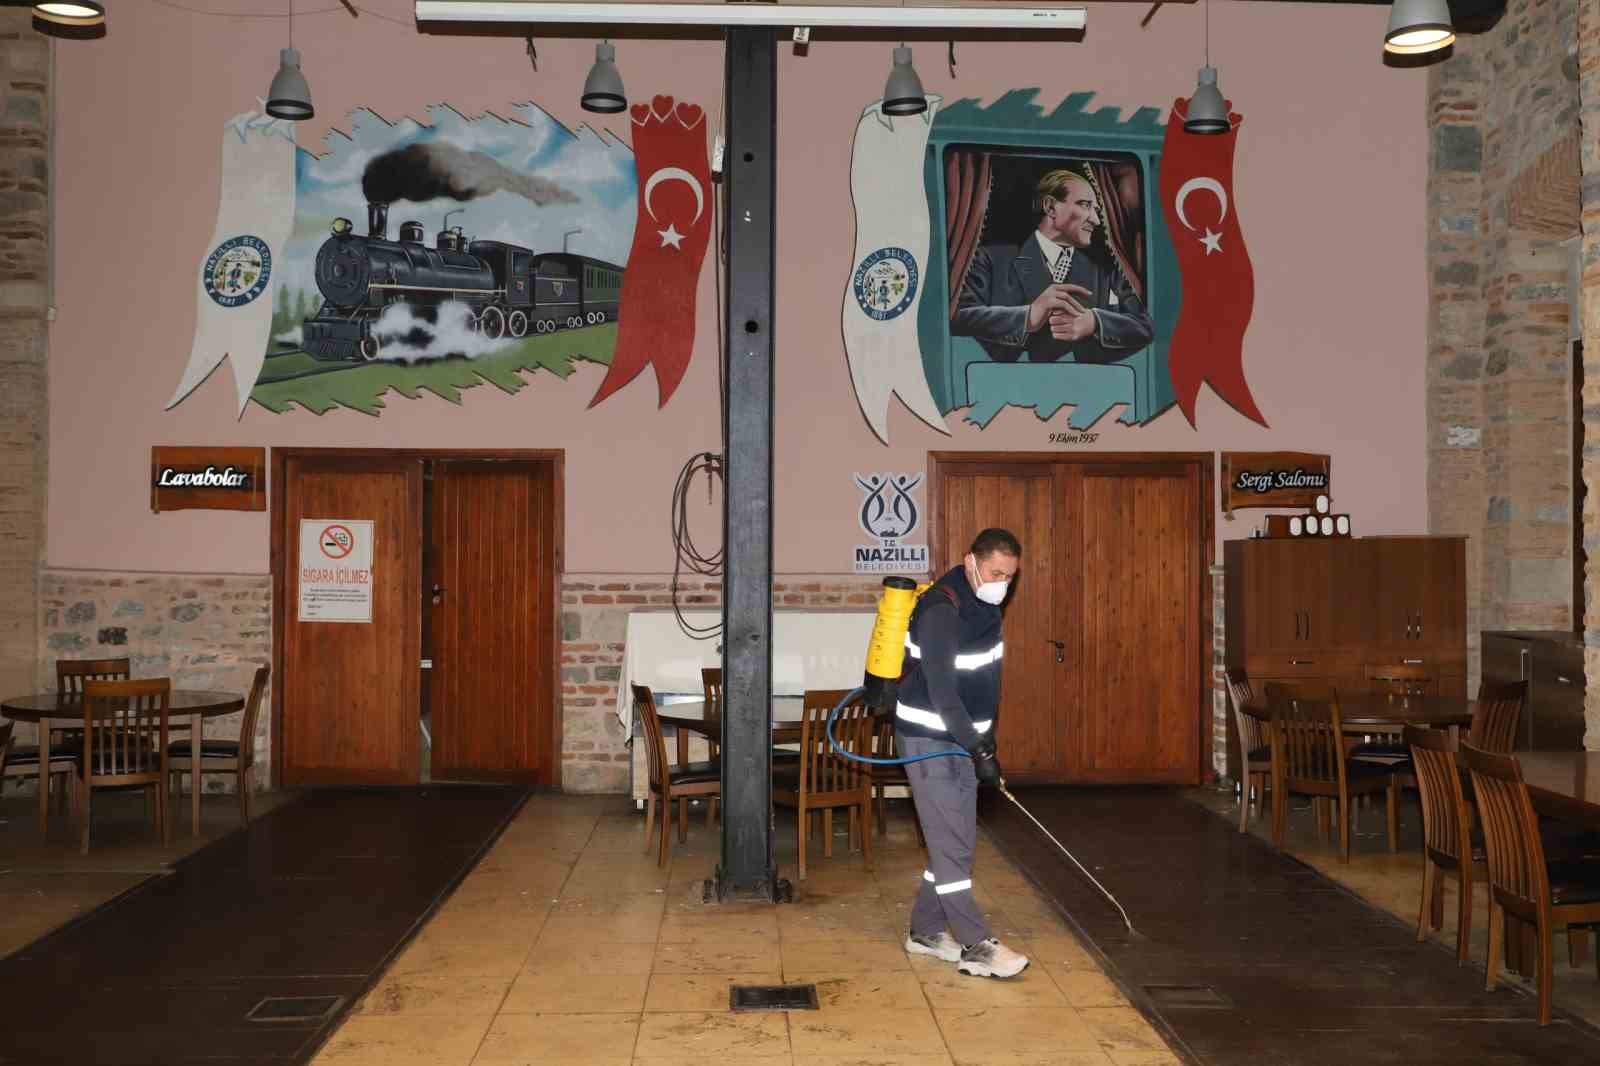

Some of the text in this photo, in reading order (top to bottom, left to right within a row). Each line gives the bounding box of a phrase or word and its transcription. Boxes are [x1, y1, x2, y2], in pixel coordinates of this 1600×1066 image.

[1048, 432, 1100, 444] 9 Ekim 1937
[158, 467, 248, 488] Lavabolar
[1236, 469, 1326, 492] Sergi Salonu
[855, 547, 927, 562] NAZİLLİ
[303, 565, 335, 585] SİGARA
